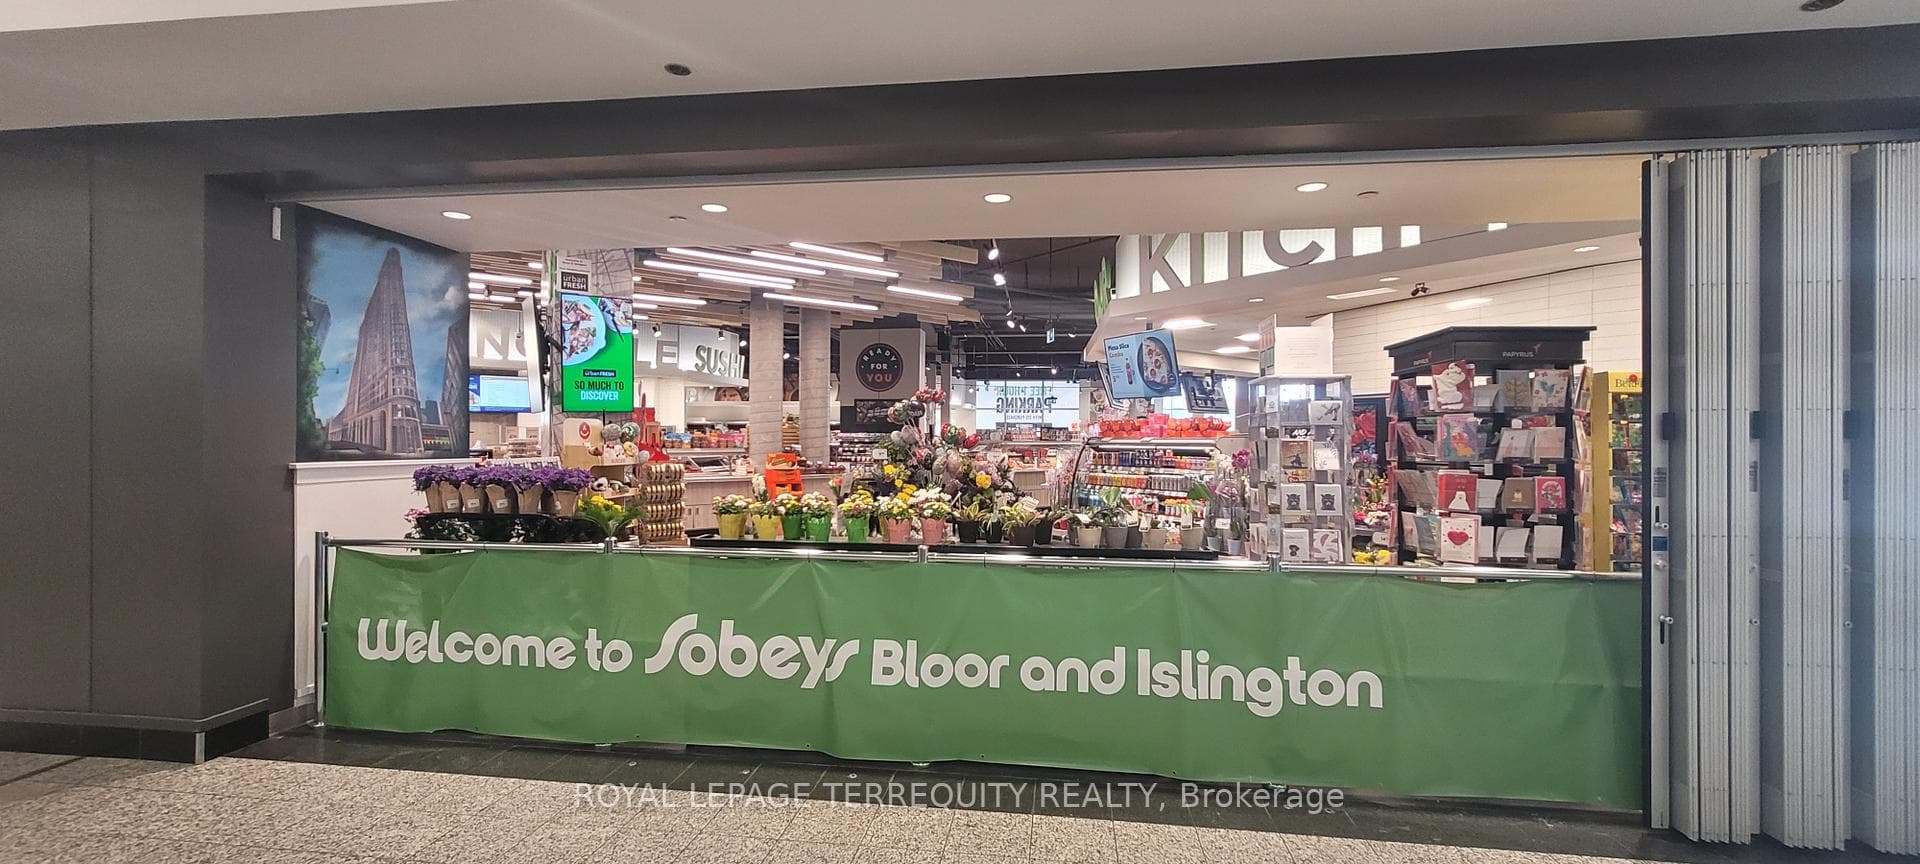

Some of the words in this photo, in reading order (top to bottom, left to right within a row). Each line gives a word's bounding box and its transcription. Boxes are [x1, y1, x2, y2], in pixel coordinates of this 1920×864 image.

[862, 348, 897, 361] READY
[695, 345, 745, 379] SUSHI
[866, 373, 892, 382] YOU
[574, 380, 585, 390] SO
[588, 380, 611, 390] MUCH
[614, 381, 624, 391] TO
[580, 390, 619, 401] DISCOVER
[358, 618, 576, 670] Welcome
[585, 628, 633, 673] to
[645, 613, 860, 689] Sobeys
[871, 639, 1010, 688] Bloor
[1020, 646, 1126, 695] and
[1137, 648, 1383, 718] Islington
